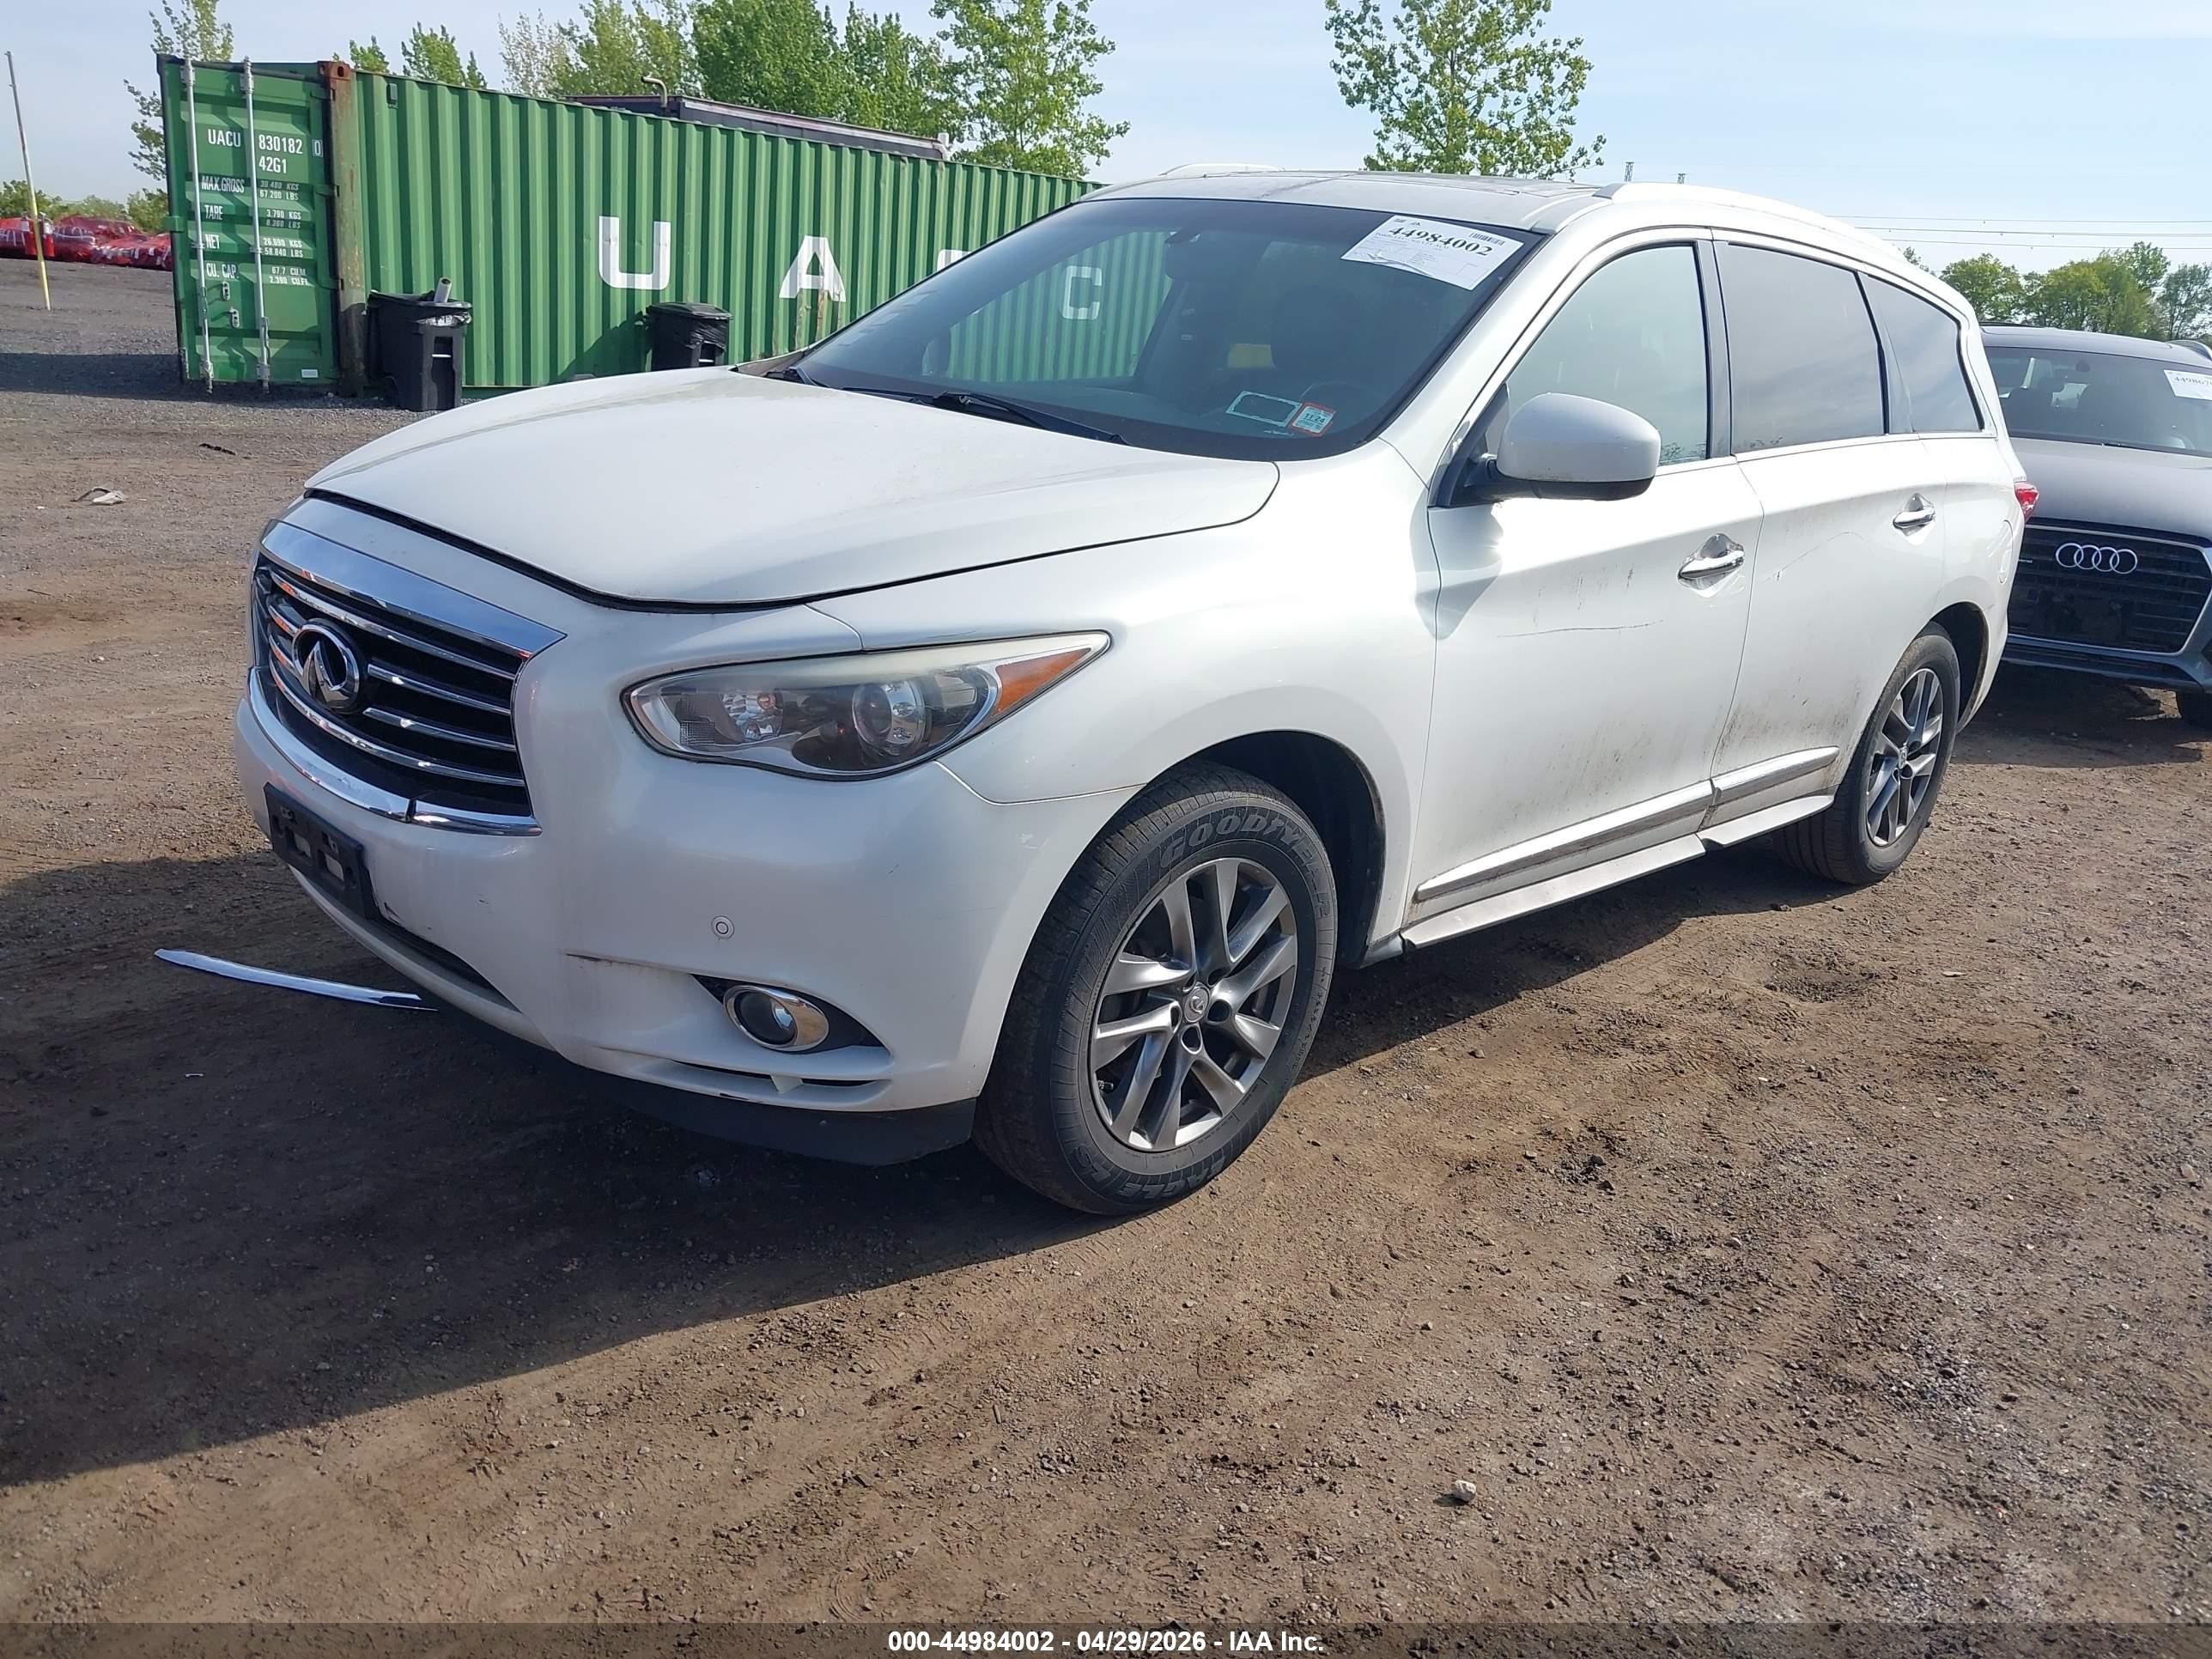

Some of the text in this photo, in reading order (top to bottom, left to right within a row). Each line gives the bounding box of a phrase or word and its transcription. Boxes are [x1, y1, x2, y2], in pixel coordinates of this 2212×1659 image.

[208, 129, 241, 148] UACU
[258, 134, 303, 155] 830182
[258, 155, 287, 174] 42G1
[286, 191, 300, 201] LBS
[204, 204, 223, 221] TARE
[289, 211, 302, 221] KGS
[205, 234, 221, 250] NET
[289, 240, 302, 249] KGS
[1389, 227, 1493, 257] 44984002
[290, 249, 304, 258] LBS
